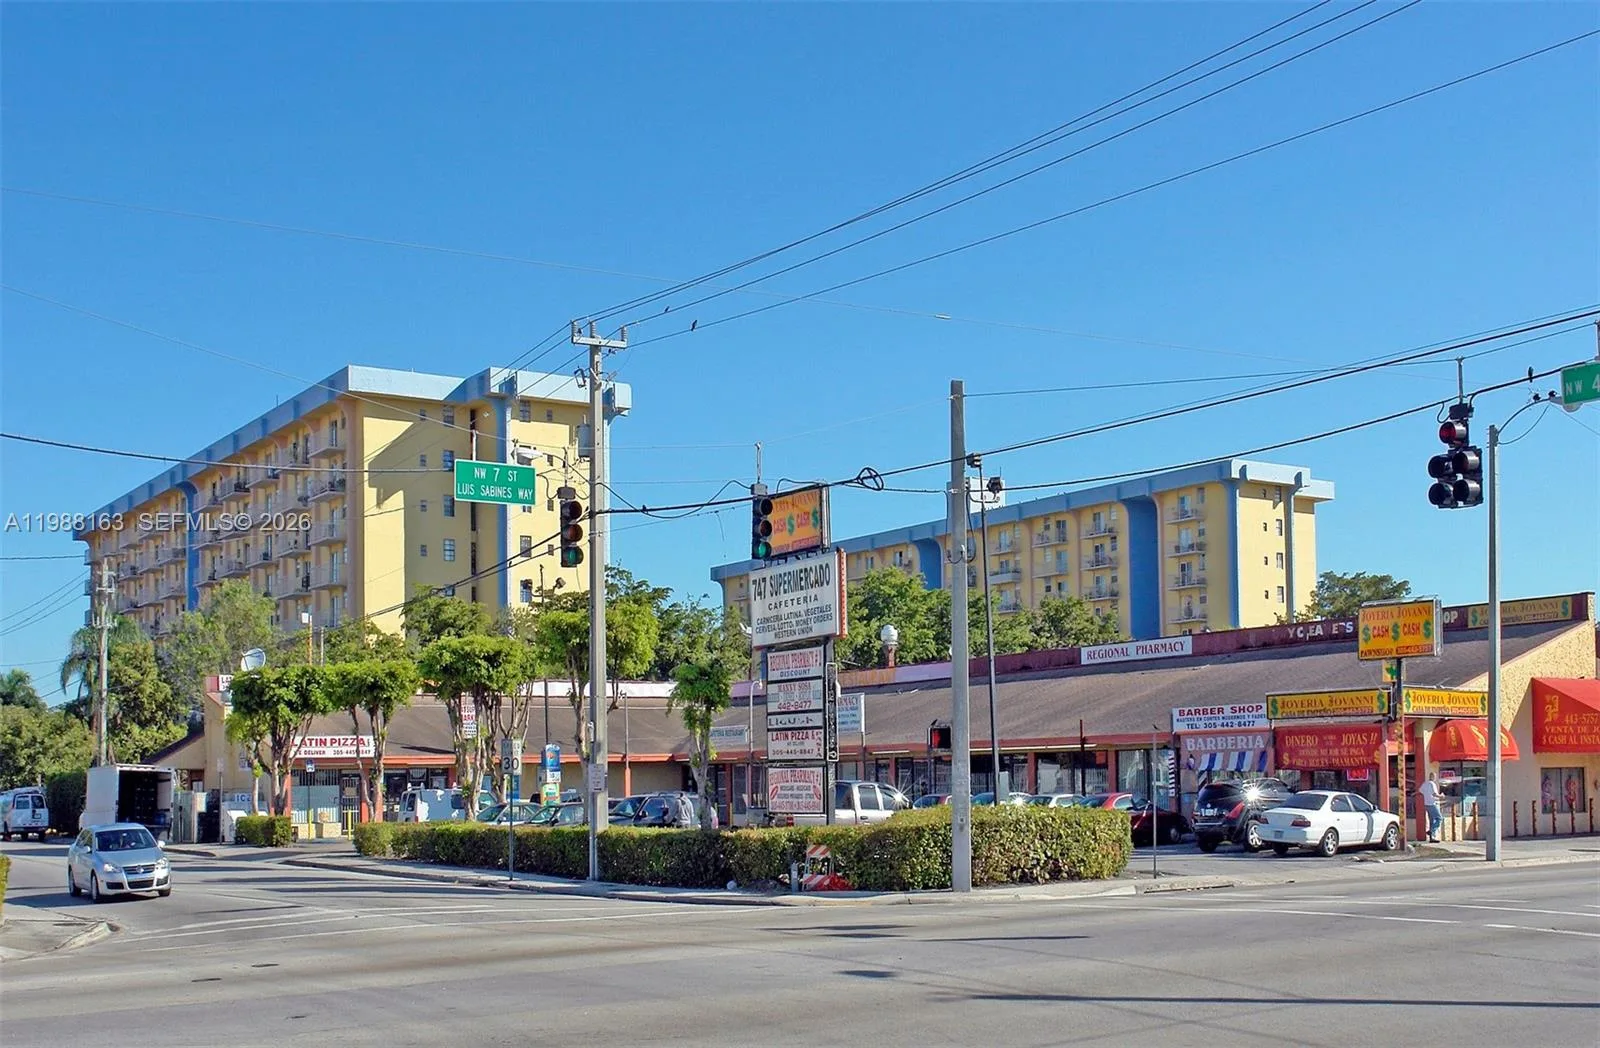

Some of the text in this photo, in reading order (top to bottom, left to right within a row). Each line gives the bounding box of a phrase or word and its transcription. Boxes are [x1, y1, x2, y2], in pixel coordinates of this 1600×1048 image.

[1565, 380, 1583, 396] NW
[474, 467, 517, 482] NW 7 ST
[457, 483, 533, 500] LUIS SABINES WAY
[752, 563, 831, 601] 747 SUPERMERCADO
[768, 594, 818, 611] CAFETERIA
[1361, 605, 1432, 621] JOYERIA JOVANNI
[1372, 624, 1389, 638] CASH
[1402, 622, 1420, 636] CASH
[1086, 641, 1185, 661] REGIONAL PHARMACY
[780, 669, 810, 678] DISCOUNT
[1280, 698, 1324, 709] JOYERIA
[1328, 695, 1374, 707] JOVANNI
[1412, 691, 1444, 704] JOYERIA
[1447, 693, 1479, 706] JOVANNI
[777, 701, 812, 711] 442-8477
[1178, 704, 1263, 717] BARBER SHOP
[1565, 712, 1598, 725] 443-5757
[1544, 725, 1574, 733] VENTA
[1577, 725, 1587, 733] DE
[290, 737, 327, 747] LATIN
[329, 737, 366, 747] PIZZA
[771, 731, 789, 742] LATIN
[790, 731, 809, 741] PIZZA
[1186, 735, 1265, 751] BARBERIA
[1285, 735, 1319, 746] DINERO
[1341, 733, 1368, 746] JOYAS
[1548, 735, 1567, 745] CASH
[1568, 735, 1578, 745] AL
[503, 757, 520, 770] 30
